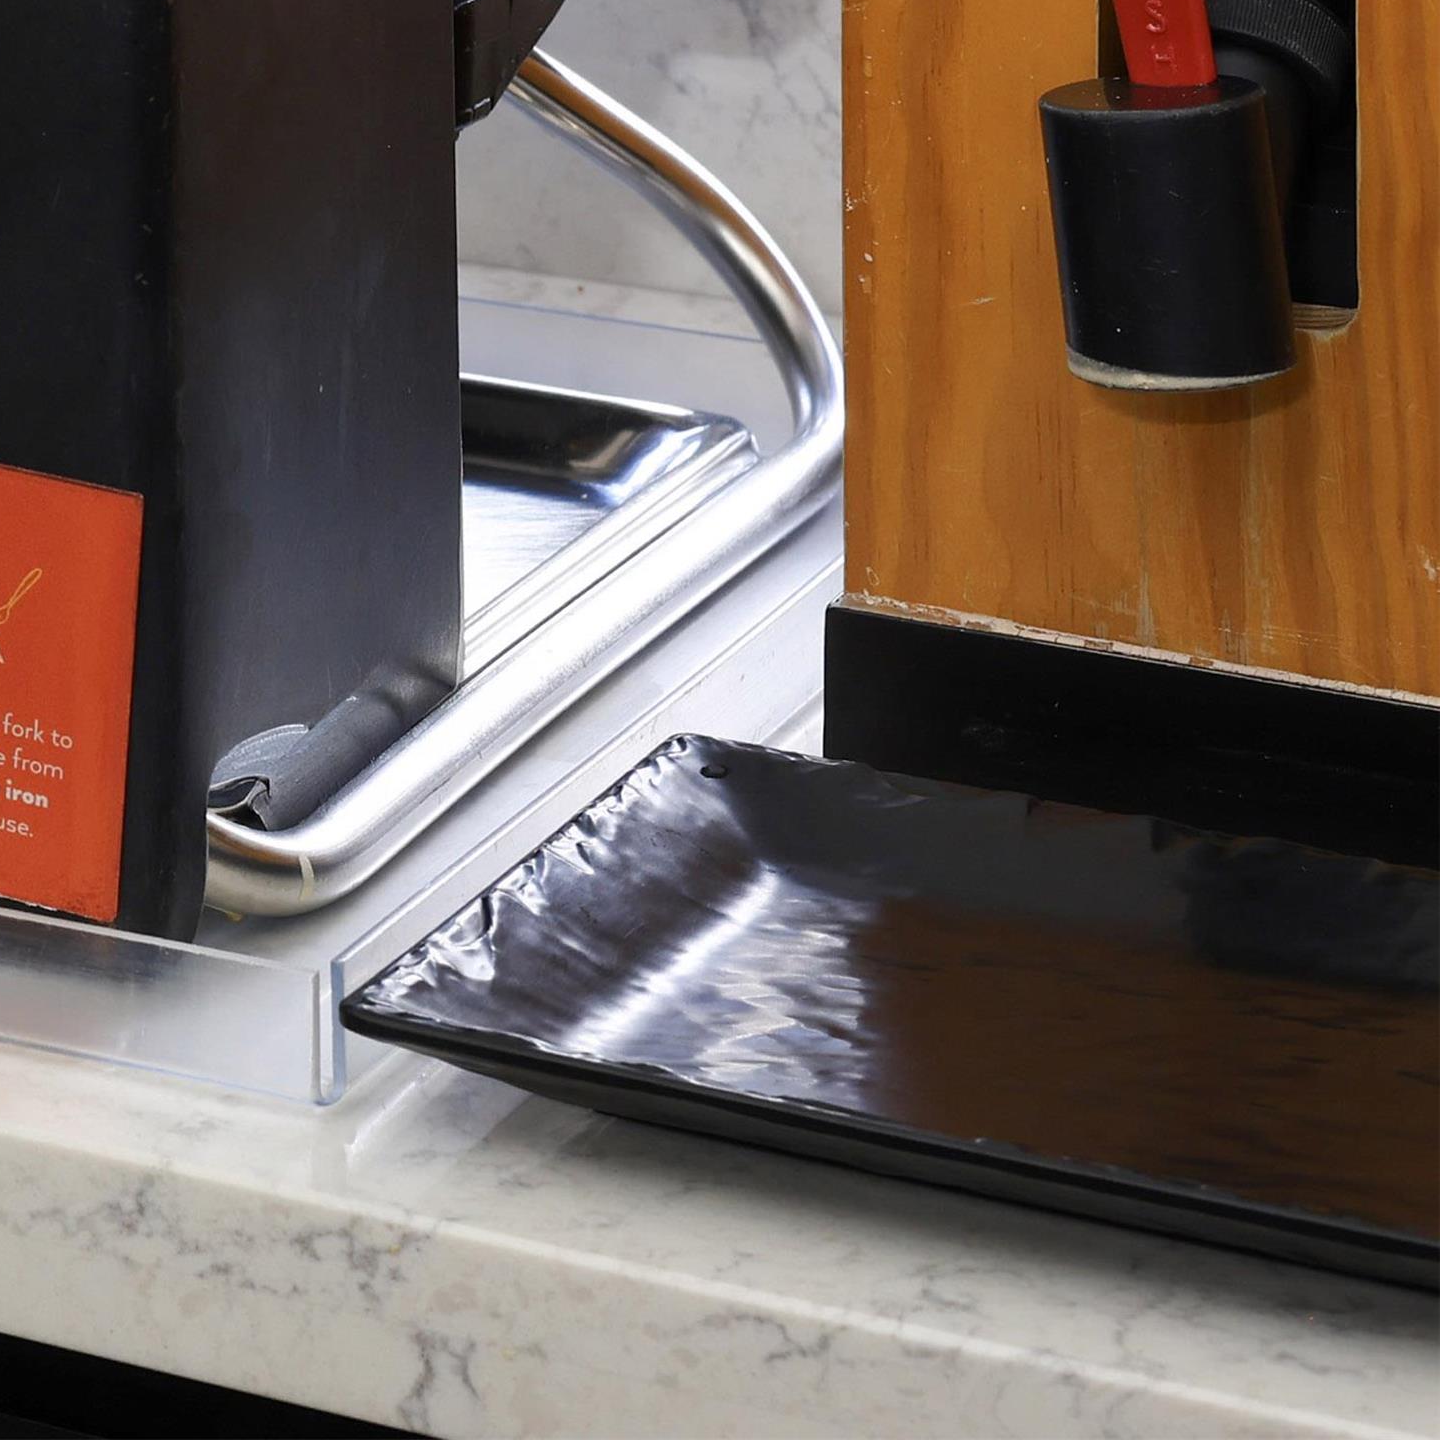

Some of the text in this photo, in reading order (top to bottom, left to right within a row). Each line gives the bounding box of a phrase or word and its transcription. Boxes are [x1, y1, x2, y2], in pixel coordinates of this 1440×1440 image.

[2, 712, 45, 743] fork
[50, 728, 73, 750] to
[12, 747, 64, 780] from
[5, 779, 49, 809] iron
